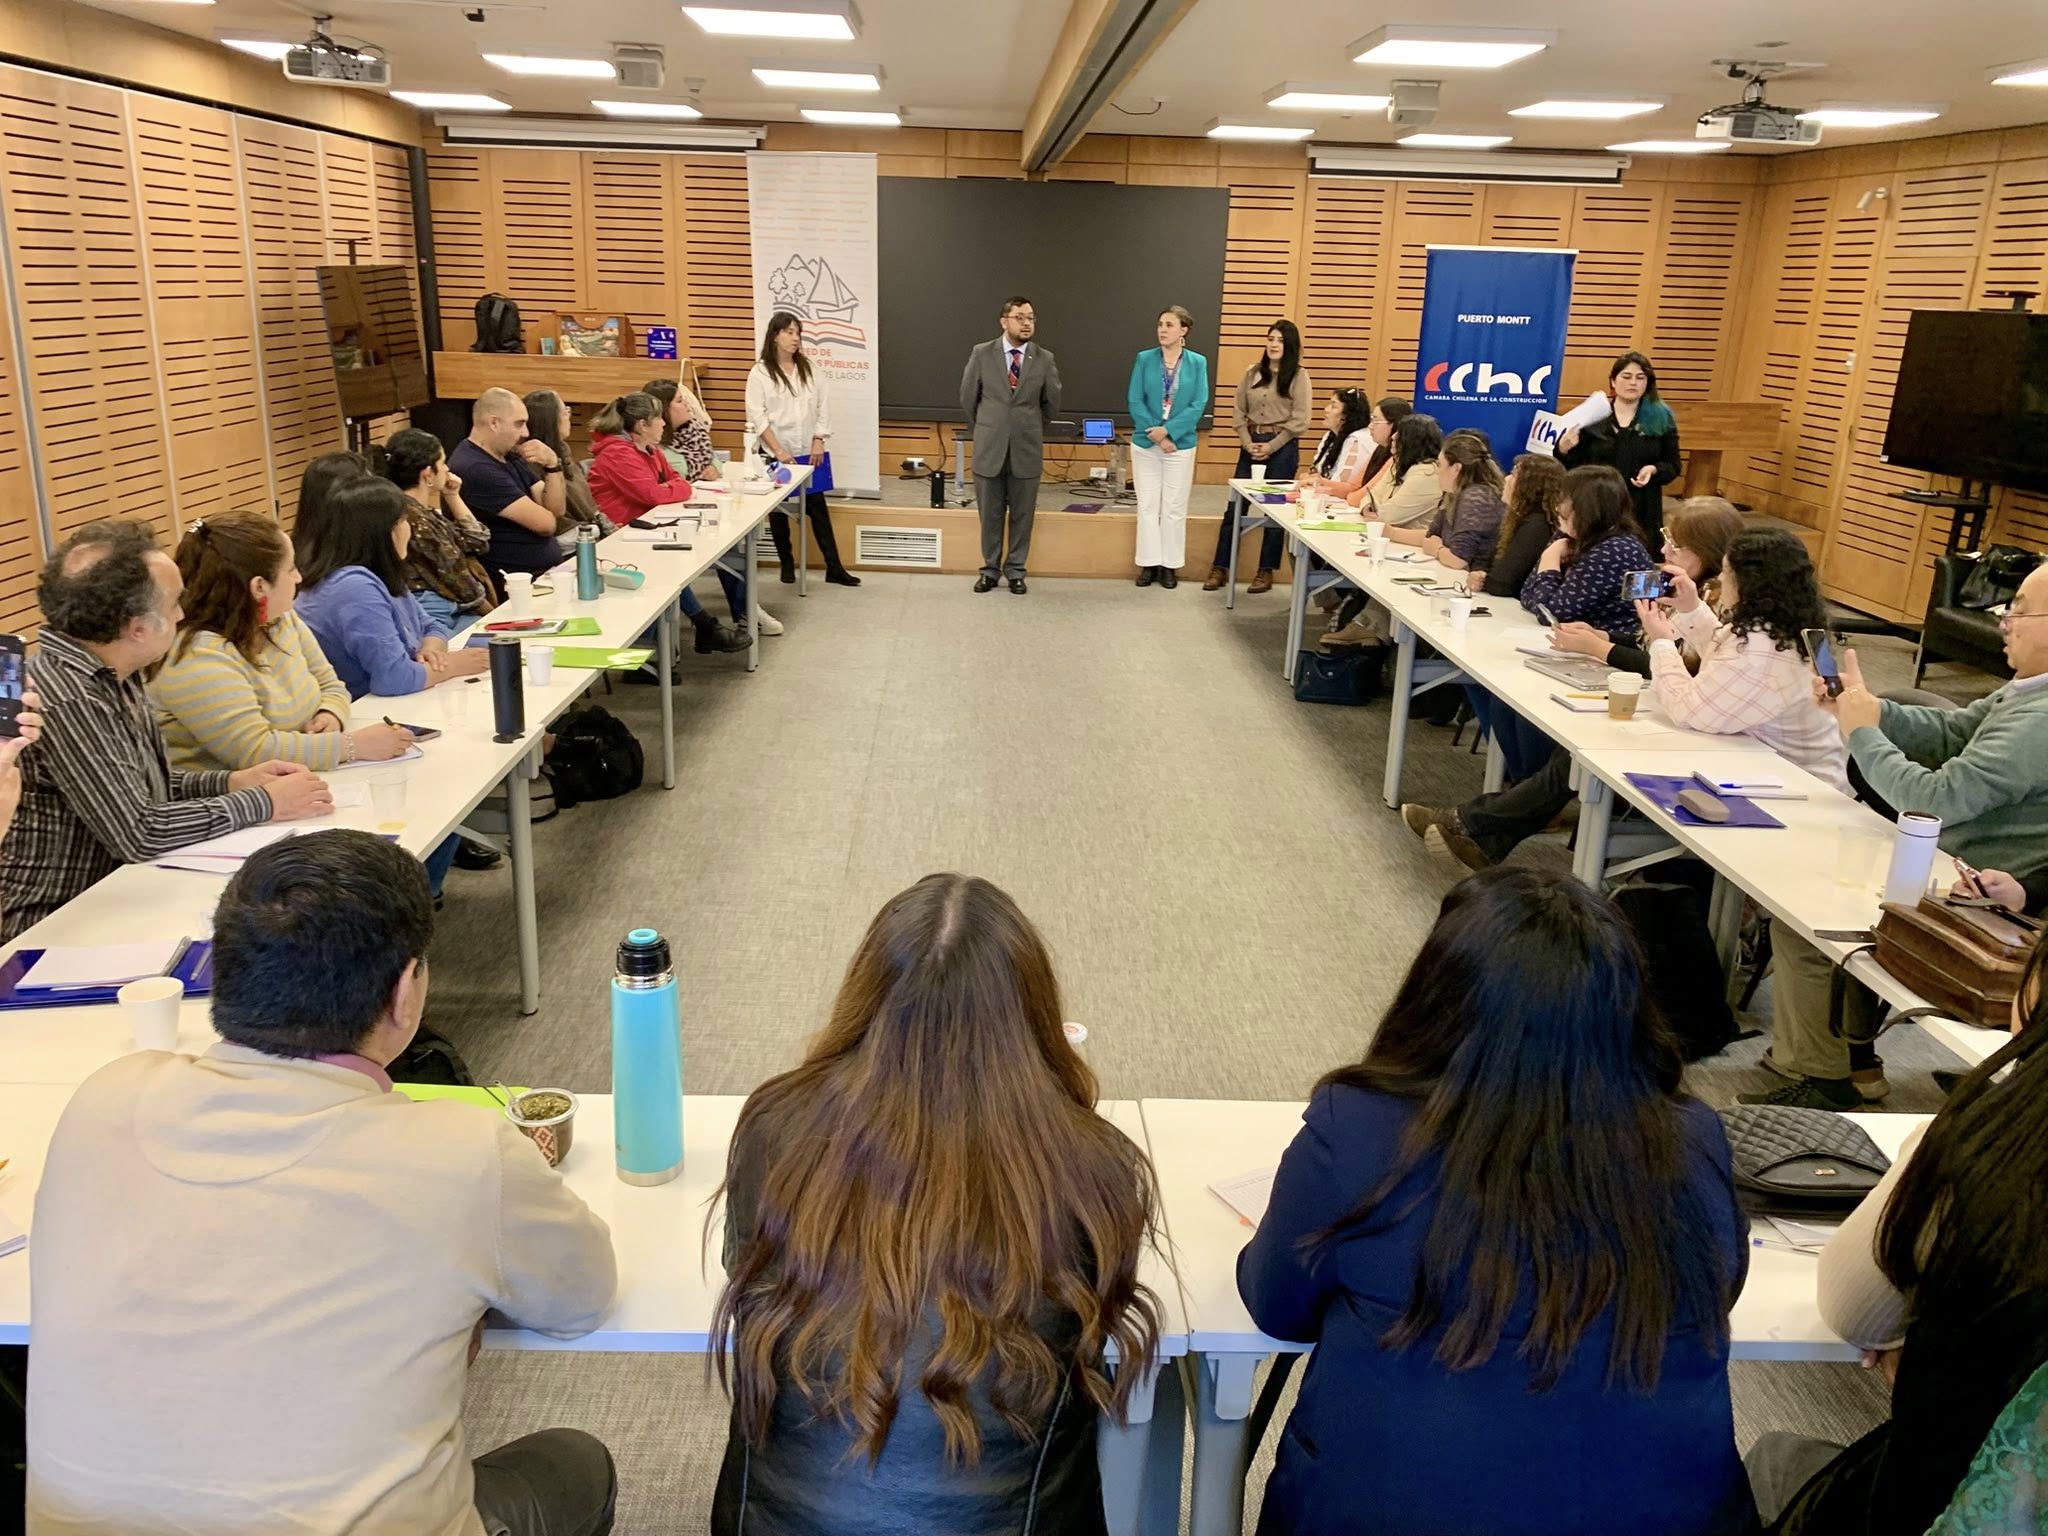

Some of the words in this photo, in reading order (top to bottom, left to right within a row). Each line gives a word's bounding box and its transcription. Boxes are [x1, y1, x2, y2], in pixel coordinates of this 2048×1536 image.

[1457, 314, 1494, 324] PUERTO
[1496, 315, 1531, 325] MONTT
[820, 348, 832, 357] DE
[835, 371, 866, 381] LAGOS
